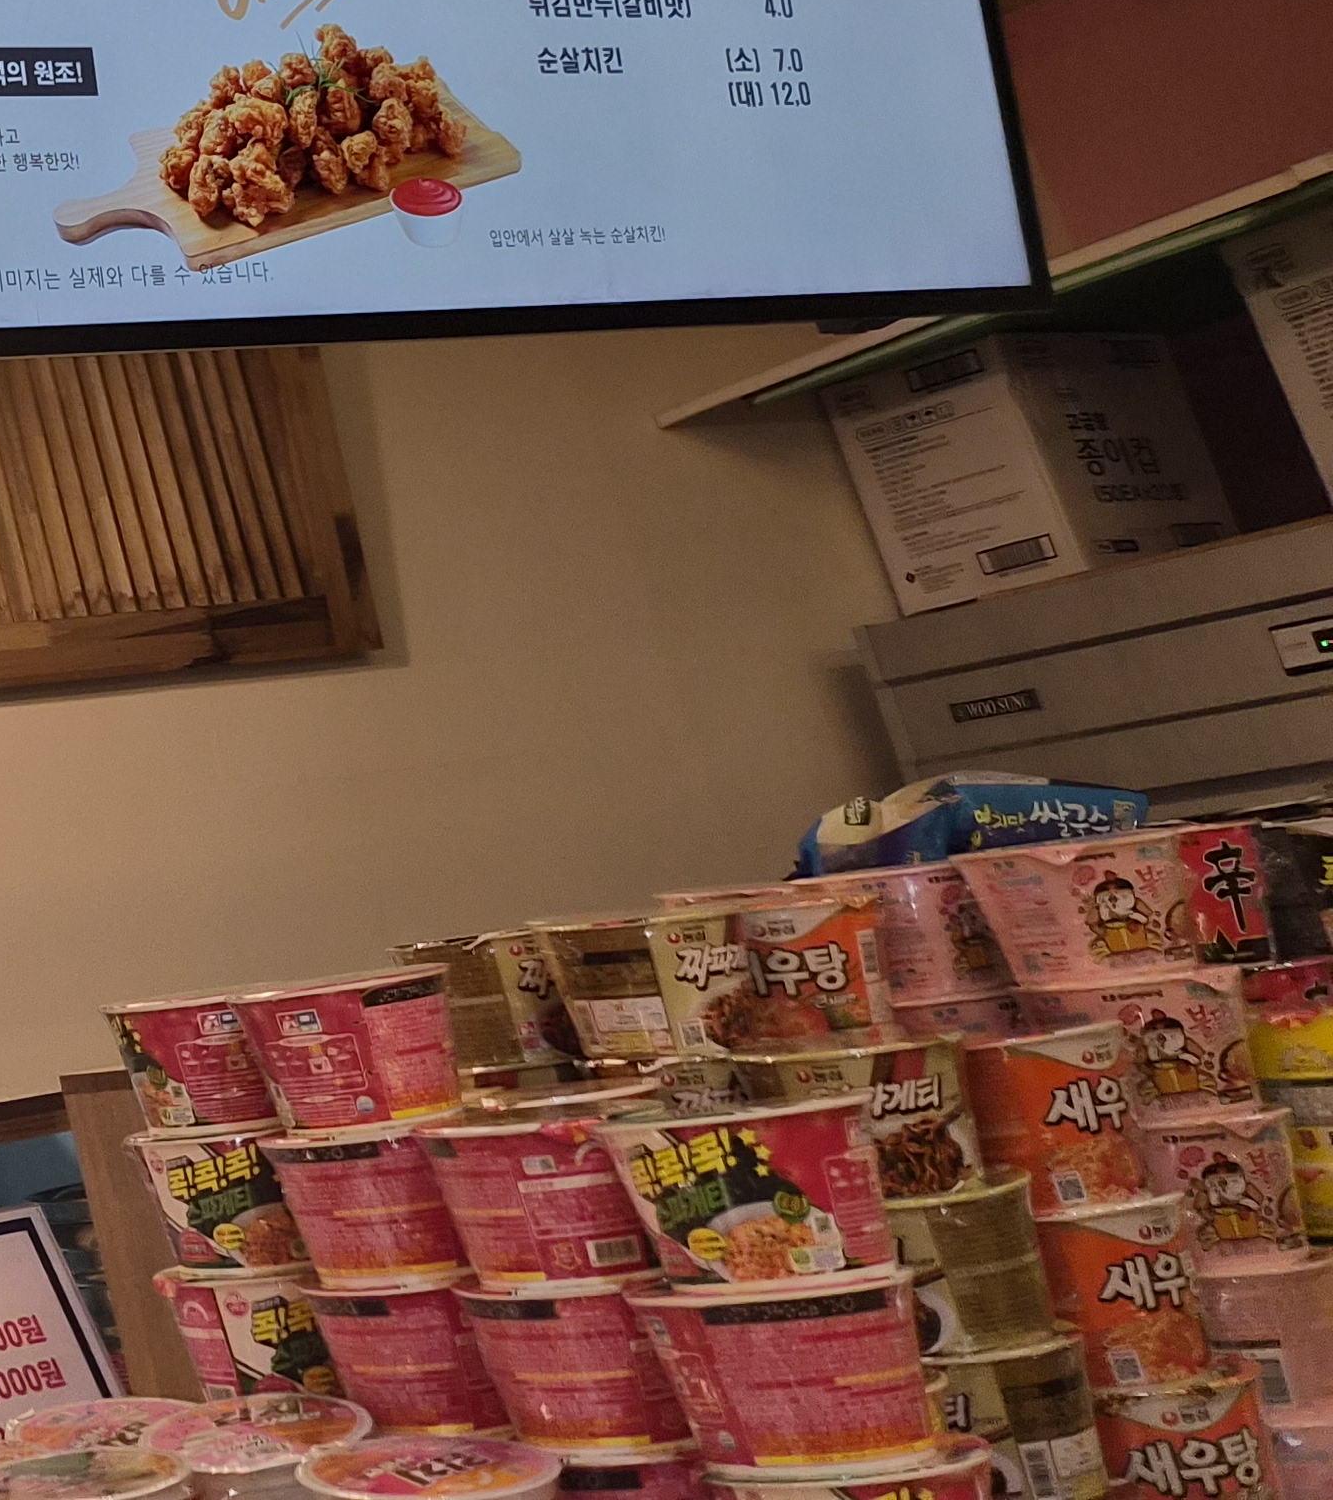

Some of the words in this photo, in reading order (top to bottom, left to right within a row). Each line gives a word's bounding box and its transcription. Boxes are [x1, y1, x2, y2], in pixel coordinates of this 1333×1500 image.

[34, 61, 83, 85] 원조!
[538, 47, 623, 73] 순살치킨
[726, 48, 760, 72] (소)
[773, 49, 803, 72] 7.0
[729, 81, 763, 107] (대)
[13, 152, 78, 171] 행복한맛!
[490, 229, 543, 247] 입안에서
[549, 228, 574, 245] 살살
[580, 228, 605, 244] 녹는
[611, 226, 665, 243] 순살치킨!
[69, 266, 123, 288] 실제와
[132, 265, 165, 287] 다를
[175, 260, 194, 285] 수
[198, 259, 274, 287] 있습니다.
[1073, 437, 1161, 477] 종이컵
[1202, 839, 1257, 934] 辛
